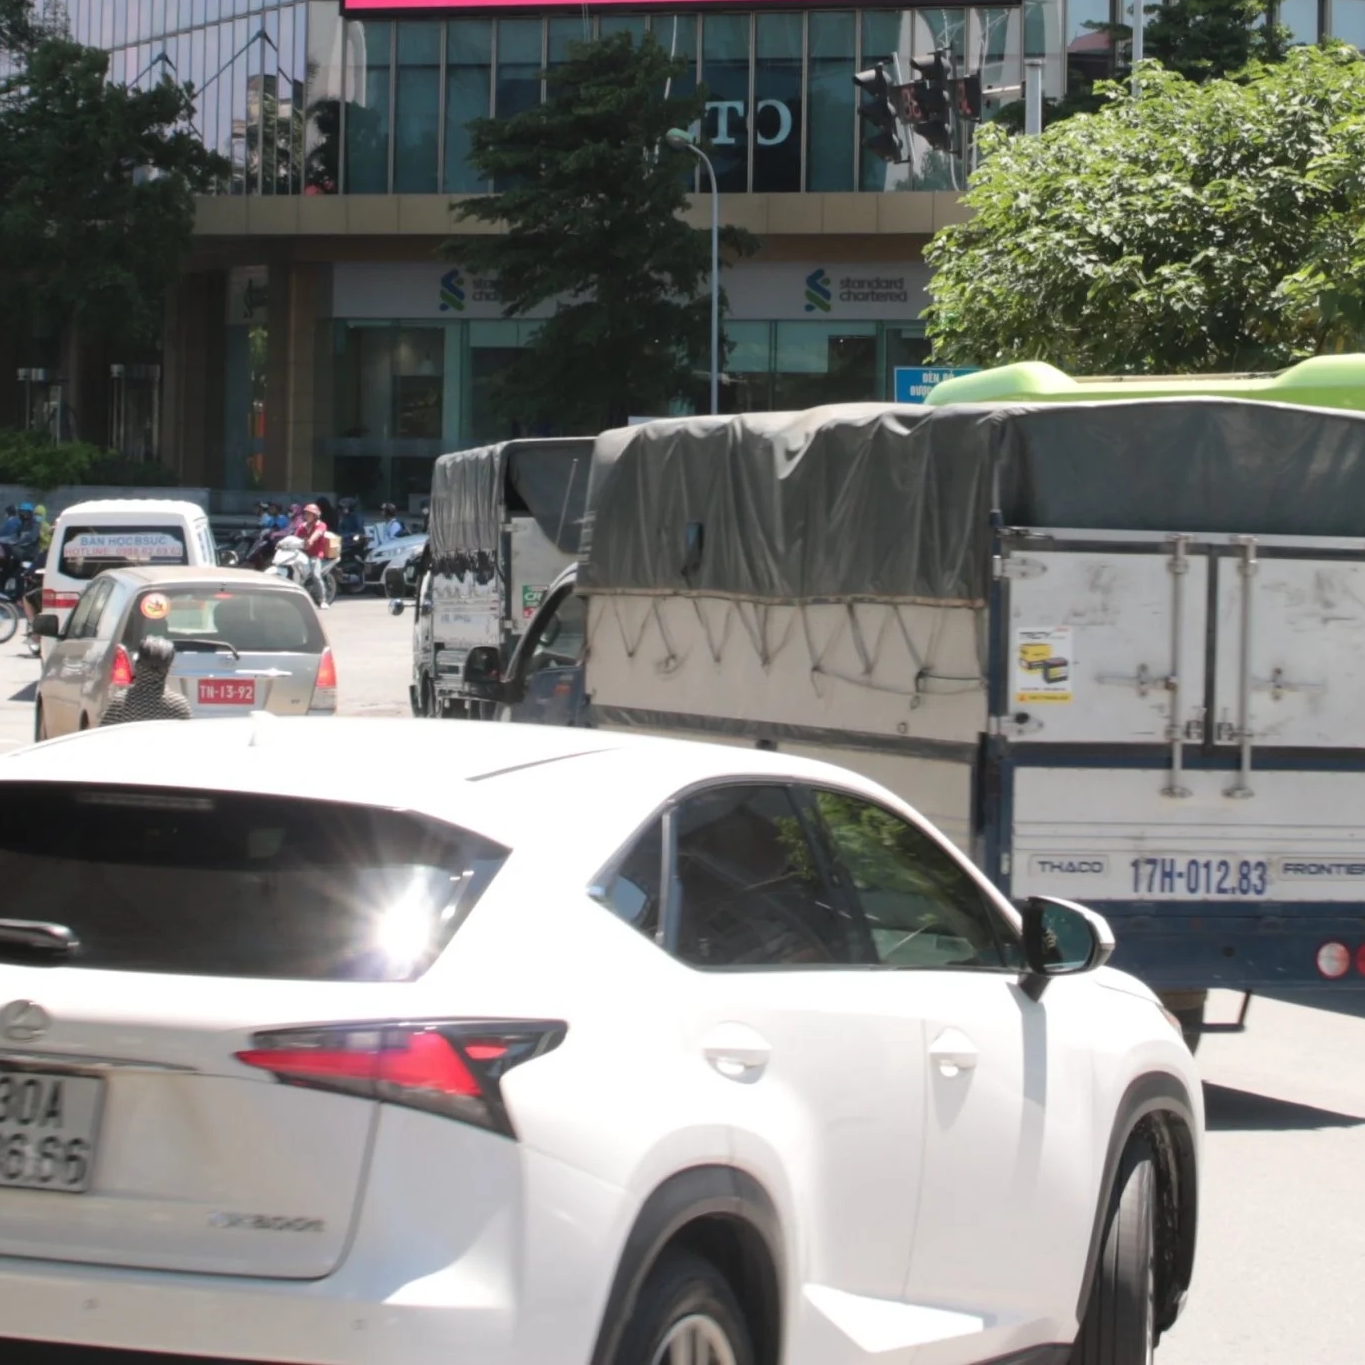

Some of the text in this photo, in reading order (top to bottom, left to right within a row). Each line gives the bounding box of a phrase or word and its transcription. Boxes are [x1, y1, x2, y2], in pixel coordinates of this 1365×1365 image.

[839, 277, 905, 290] standard
[839, 290, 908, 302] chartered
[200, 685, 253, 699] TN-13-92
[1038, 859, 1104, 874] THACO
[1130, 857, 1269, 895] 17H-012.83
